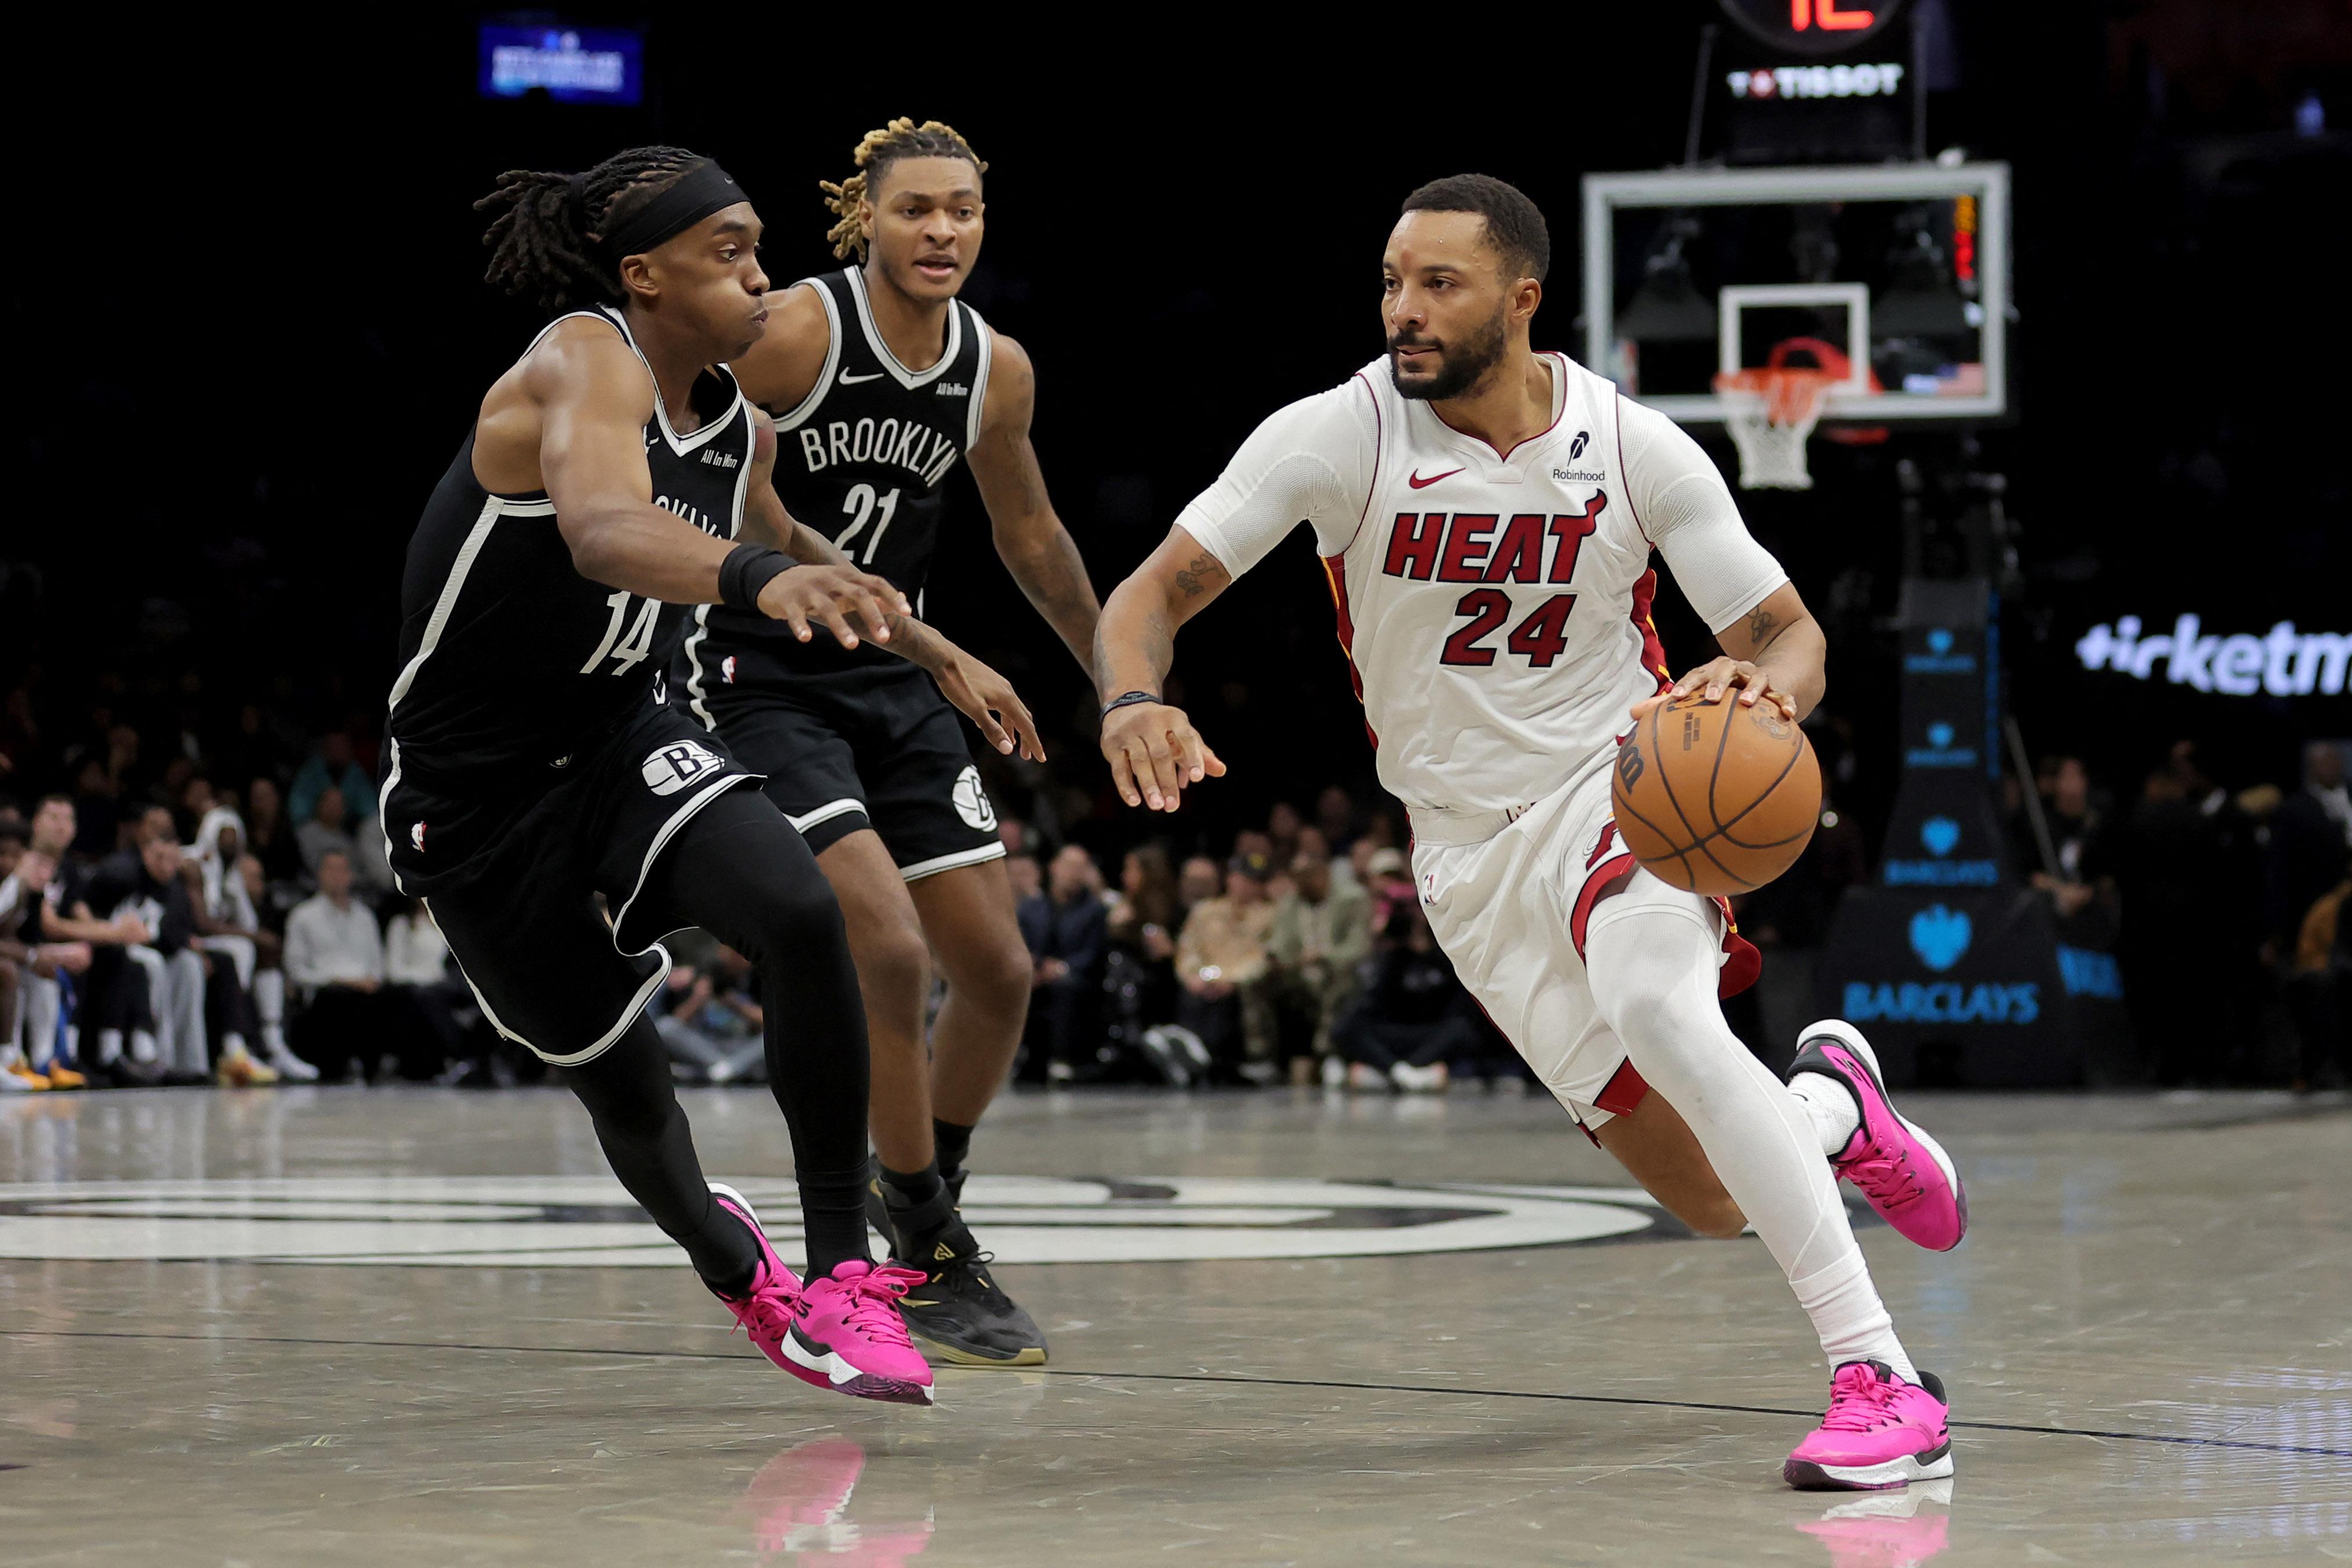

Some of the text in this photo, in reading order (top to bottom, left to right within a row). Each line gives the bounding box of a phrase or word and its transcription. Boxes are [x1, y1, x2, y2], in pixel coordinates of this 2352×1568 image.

[700, 449, 714, 464] All
[713, 451, 723, 466] In
[800, 418, 957, 488] BROOKLYN
[1553, 469, 1605, 481] Robinhood
[832, 484, 900, 565] 21
[1382, 488, 1607, 584] HEAT
[579, 590, 662, 676] 14
[1439, 588, 1578, 667] 24
[1843, 982, 2040, 1025] BARCLAYS
